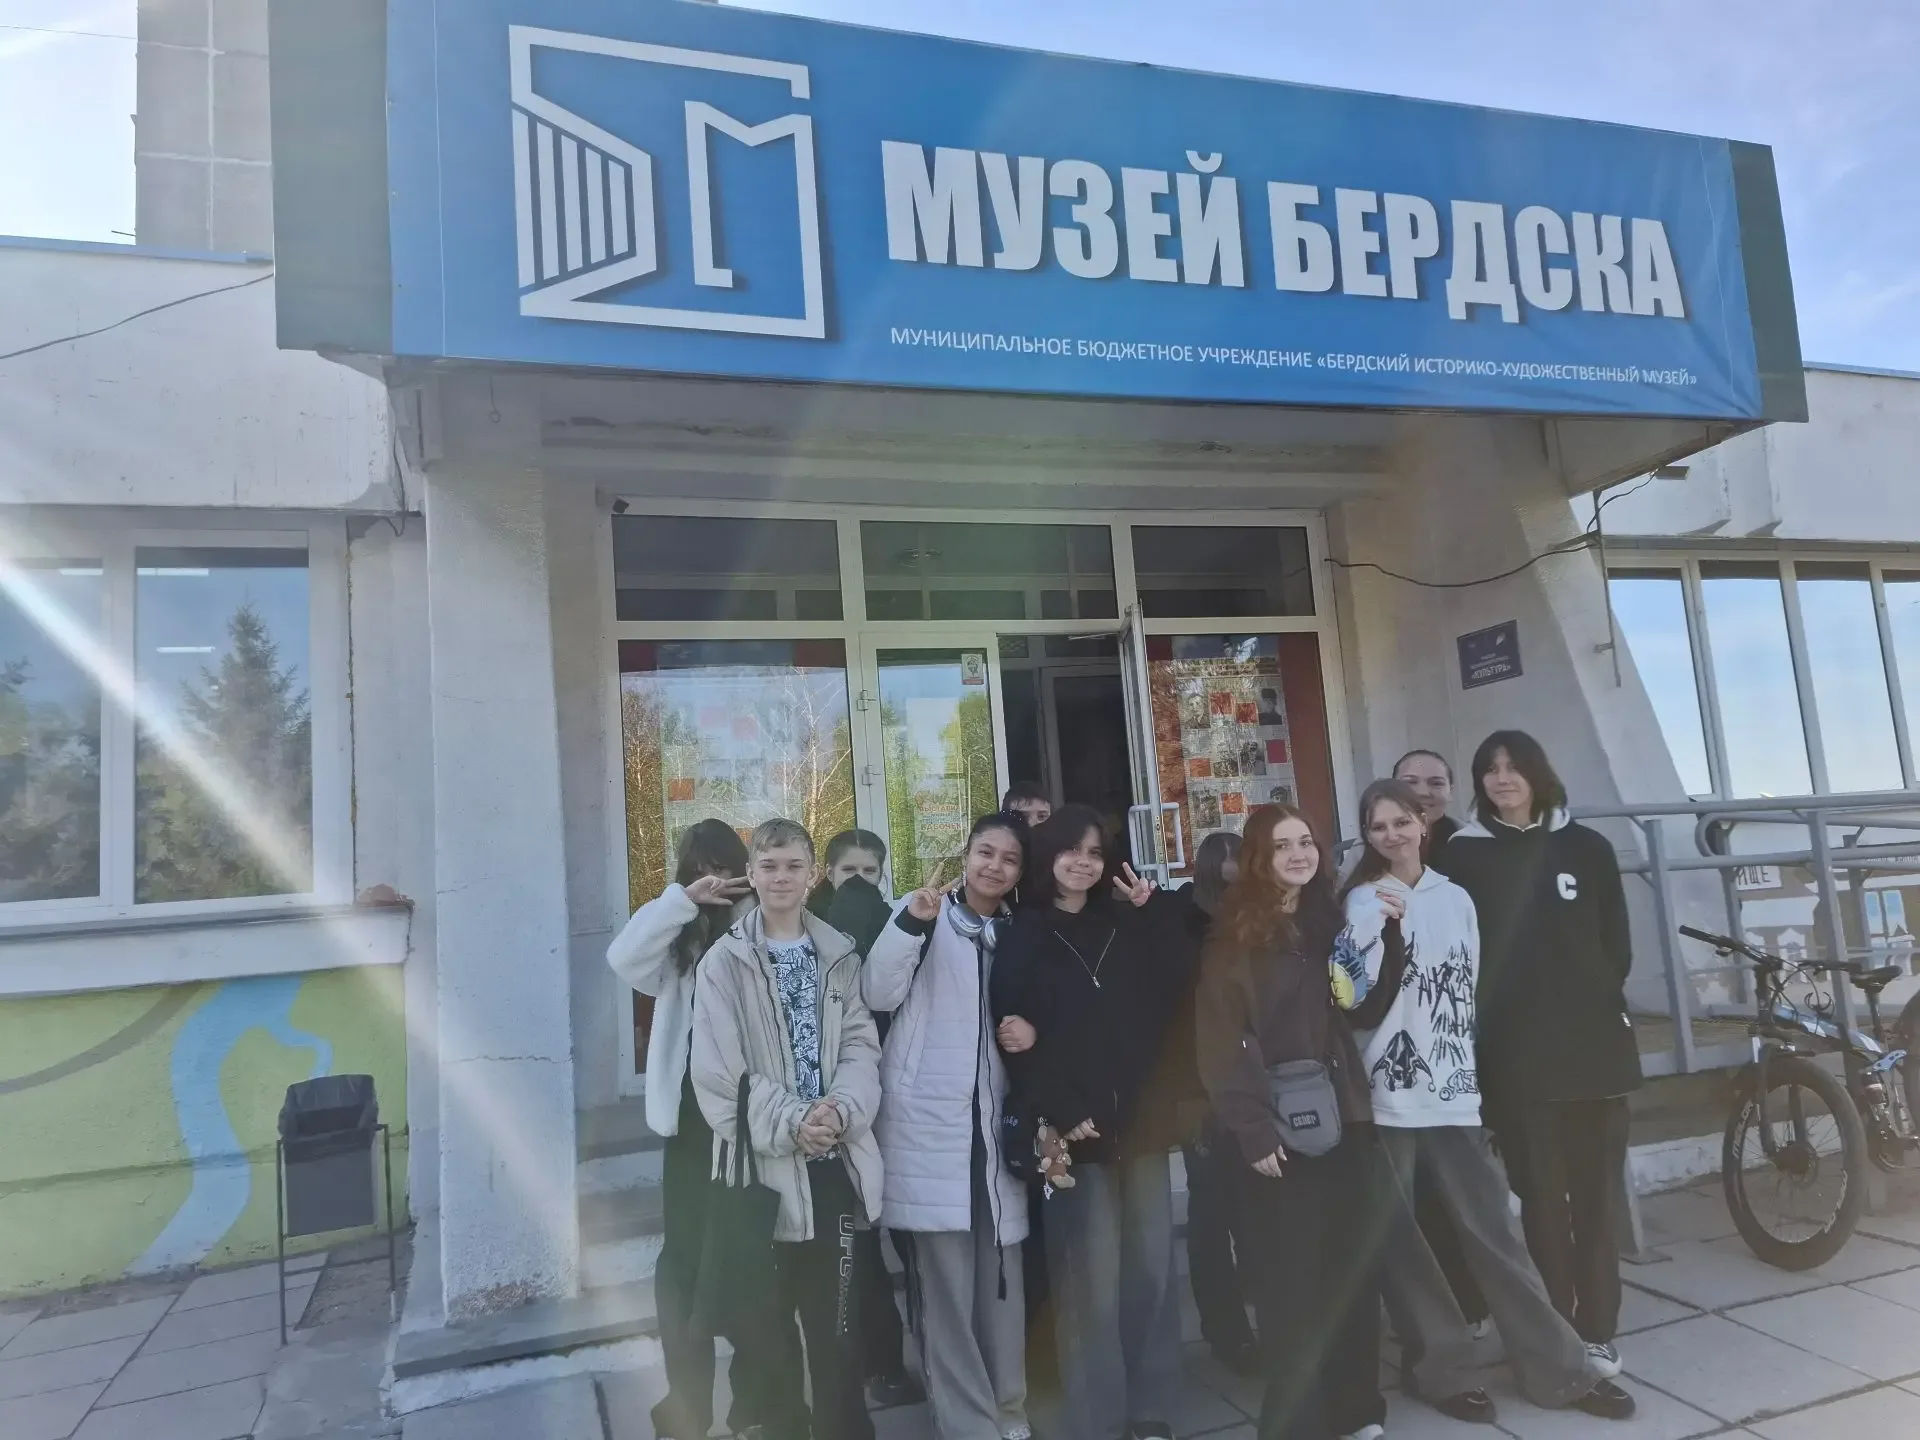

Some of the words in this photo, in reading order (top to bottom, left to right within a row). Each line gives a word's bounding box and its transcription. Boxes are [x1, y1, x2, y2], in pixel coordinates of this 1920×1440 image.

[881, 140, 1245, 288] МУЗЕЙ
[1267, 181, 1686, 323] БЕРДСКА
[890, 326, 1072, 357] МУНИЦИПАЛЬНОЕ
[1077, 339, 1194, 363] БЮДЖЕТНОЕ
[1199, 346, 1312, 369] УЧРЕЖДЕНИЕ
[1317, 353, 1410, 373] «БЕРДСКИЙ
[1414, 357, 1640, 384] ИСТОРИКО-ХУДОЖЕСТВЕННЫЙ
[1641, 366, 1697, 387] МУЗЕЙ»
[1557, 872, 1577, 900] C
